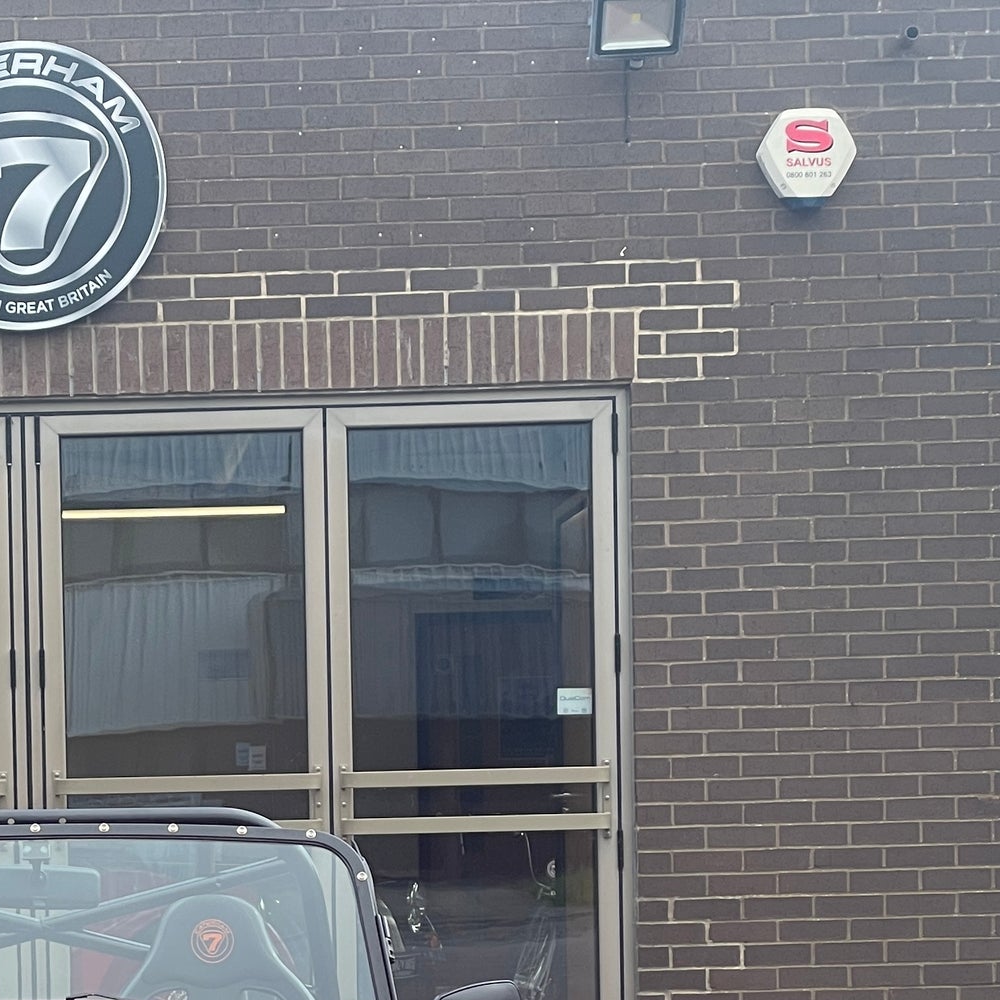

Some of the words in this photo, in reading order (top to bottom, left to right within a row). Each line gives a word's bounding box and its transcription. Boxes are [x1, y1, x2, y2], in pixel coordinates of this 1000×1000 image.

[786, 157, 832, 167] SALVUS
[5, 300, 54, 315] GREAT
[57, 269, 113, 309] BRITAIN
